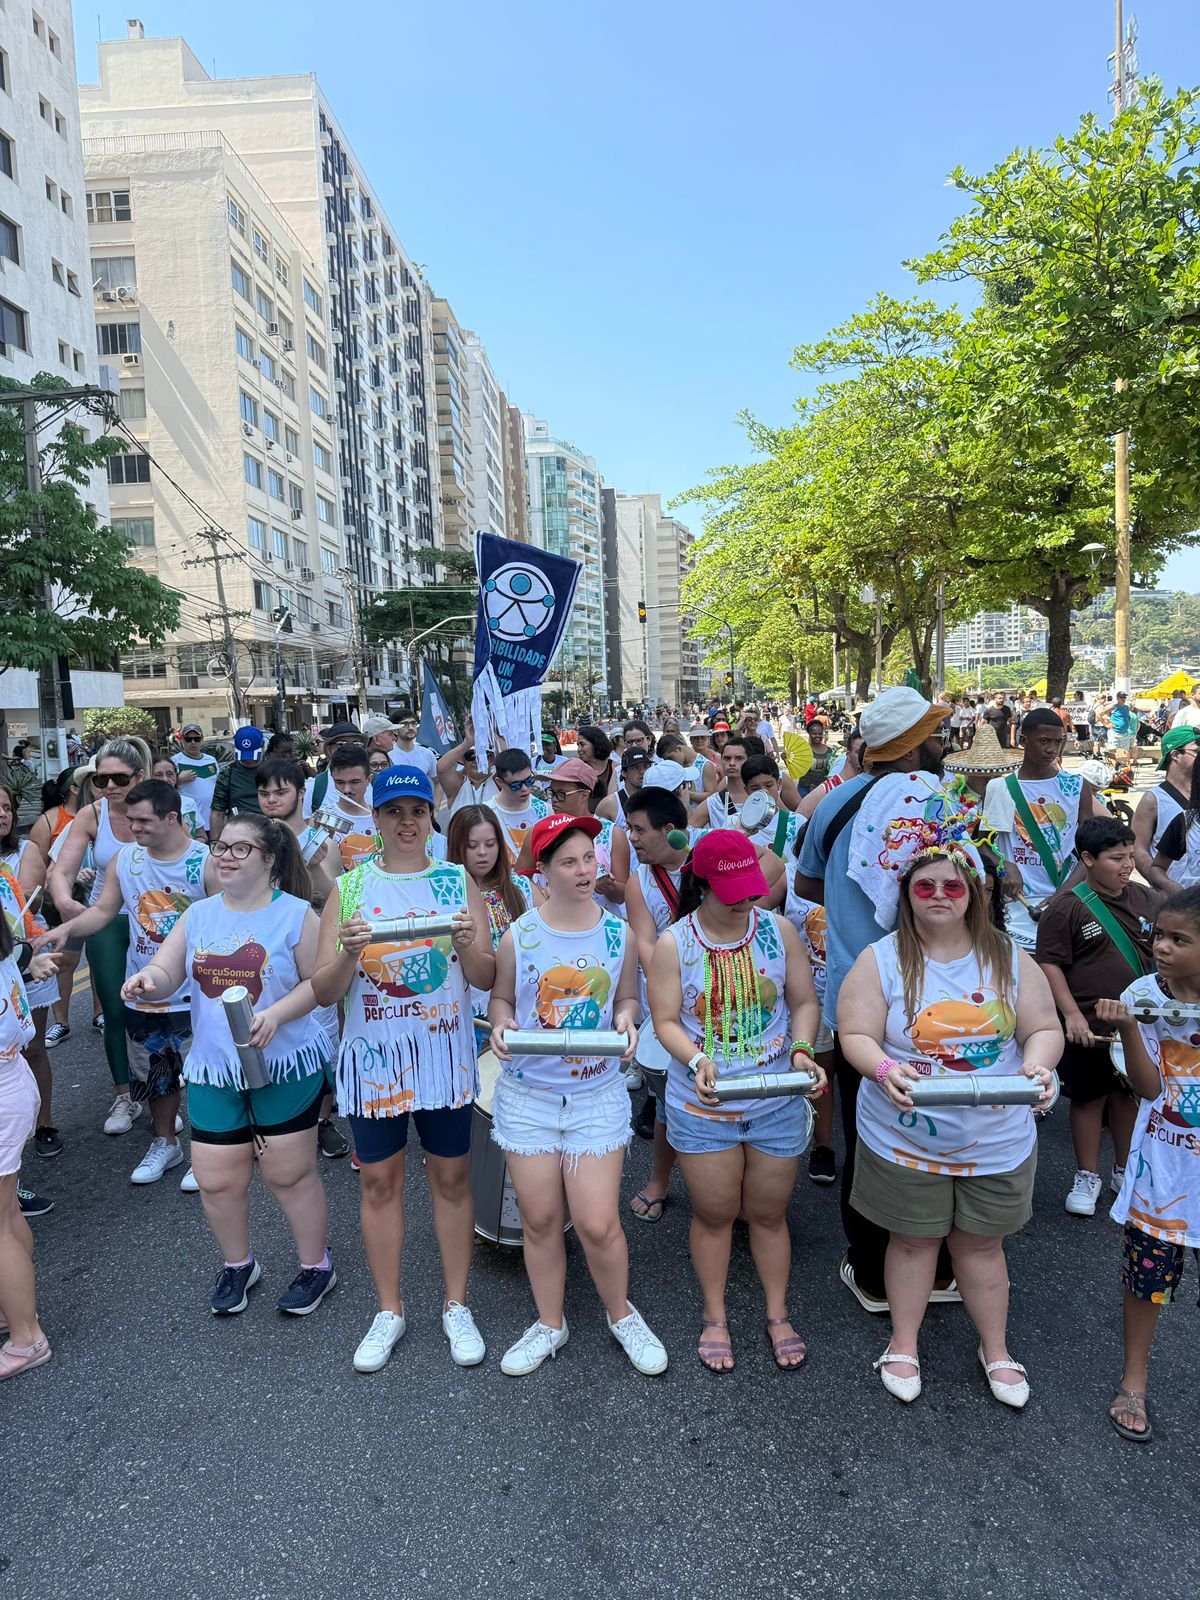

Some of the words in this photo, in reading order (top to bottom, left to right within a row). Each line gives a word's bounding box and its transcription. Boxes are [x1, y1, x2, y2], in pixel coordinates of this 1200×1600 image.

[490, 638, 547, 669] SIBILIDADE
[497, 660, 515, 677] UM
[386, 775, 420, 786] Nath
[717, 857, 755, 871] Giovanna
[212, 976, 238, 986] Amor
[580, 1058, 608, 1080] AMOR
[910, 1061, 931, 1075] OCO
